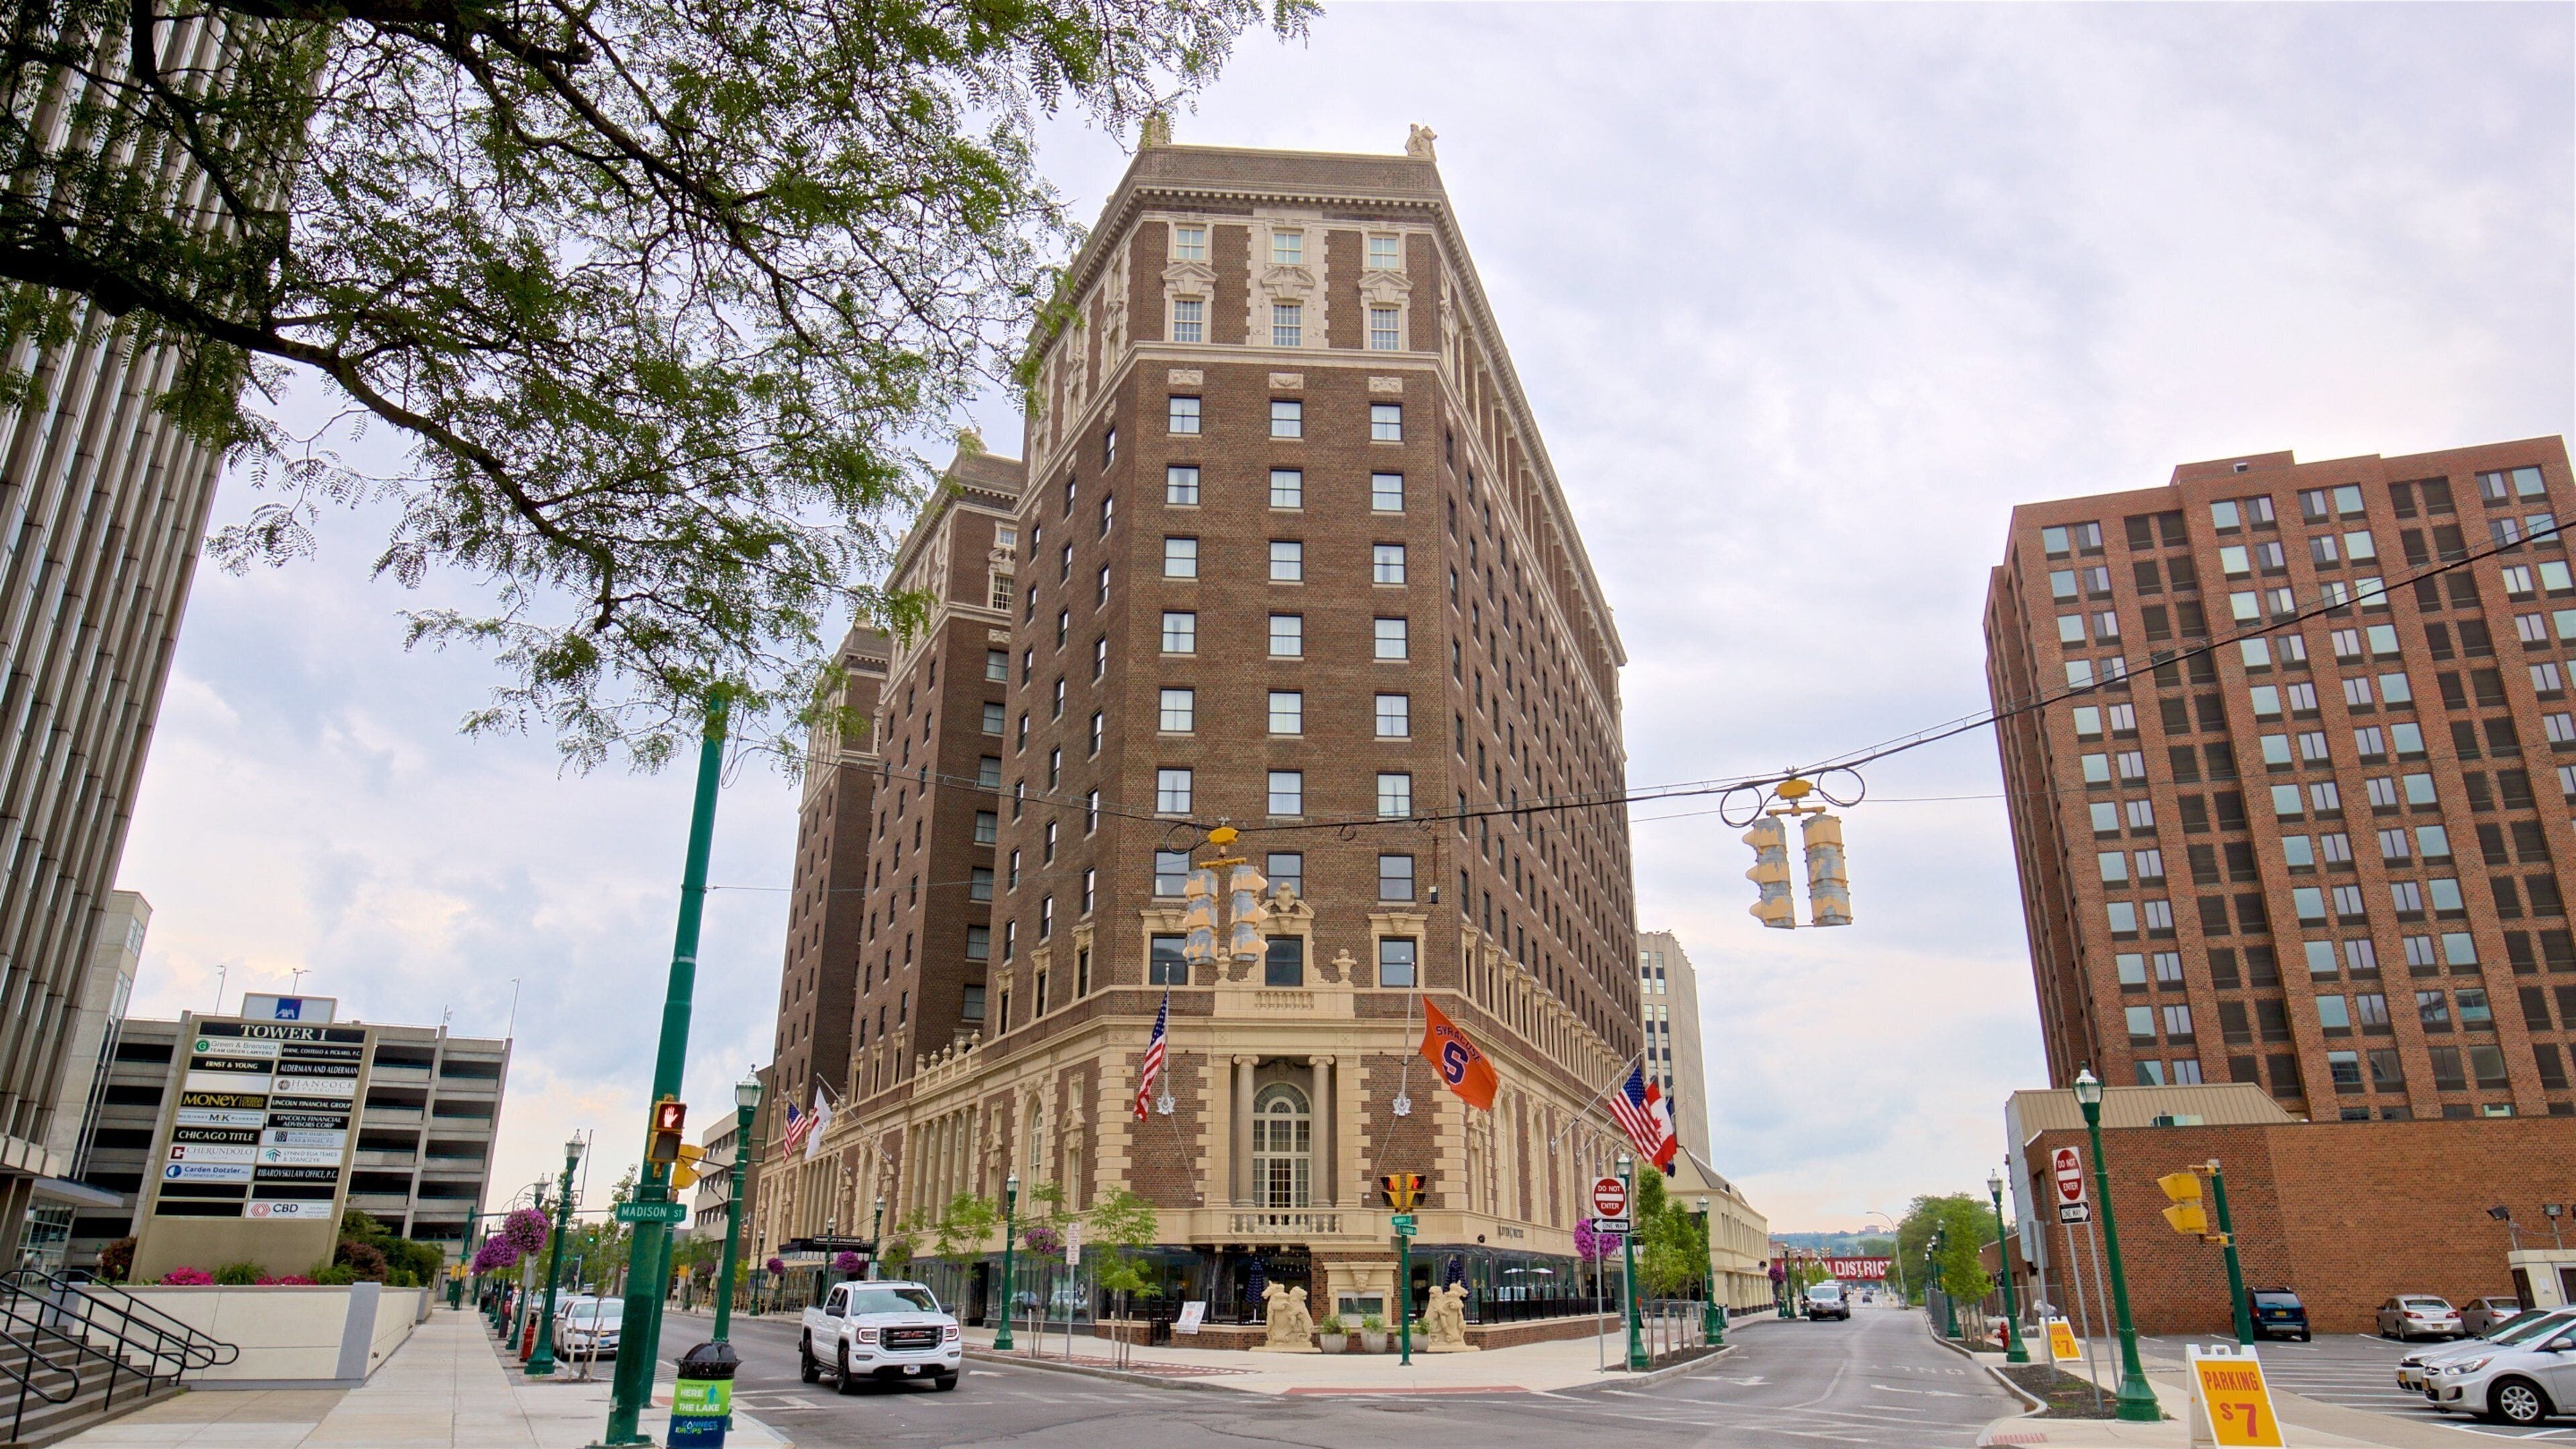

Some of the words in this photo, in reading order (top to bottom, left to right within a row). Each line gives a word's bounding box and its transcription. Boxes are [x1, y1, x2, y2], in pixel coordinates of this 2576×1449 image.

[276, 1008, 295, 1018] AXA
[240, 1024, 314, 1040] TOWER
[319, 1028, 328, 1041] I
[1436, 1025, 1481, 1063] SYRACUSE
[1442, 1040, 1470, 1085] S
[280, 1064, 312, 1073] ALDERMAN
[313, 1065, 326, 1073] AND
[327, 1066, 358, 1074] ALDERMAN
[291, 1079, 354, 1089] HANCOCK
[178, 1130, 227, 1140] CHICAGO
[229, 1132, 255, 1141] TITLE
[186, 1146, 253, 1155] CHERUNDOLO
[2057, 1160, 2065, 1169] DO
[2066, 1158, 2076, 1167] NOT
[257, 1169, 290, 1177] RIBAROVSKI
[305, 1171, 326, 1179] OFFICE,
[326, 1171, 337, 1179] P.C.
[2063, 1181, 2079, 1192] ENTER
[273, 1203, 299, 1213] CBD
[621, 1207, 667, 1218] MADISON
[674, 1210, 683, 1218] ST
[2072, 1209, 2082, 1217] WAY
[2203, 1371, 2260, 1391] PARKING
[680, 1389, 704, 1397] HERE
[679, 1403, 694, 1411] THE
[696, 1403, 720, 1412] LAKE
